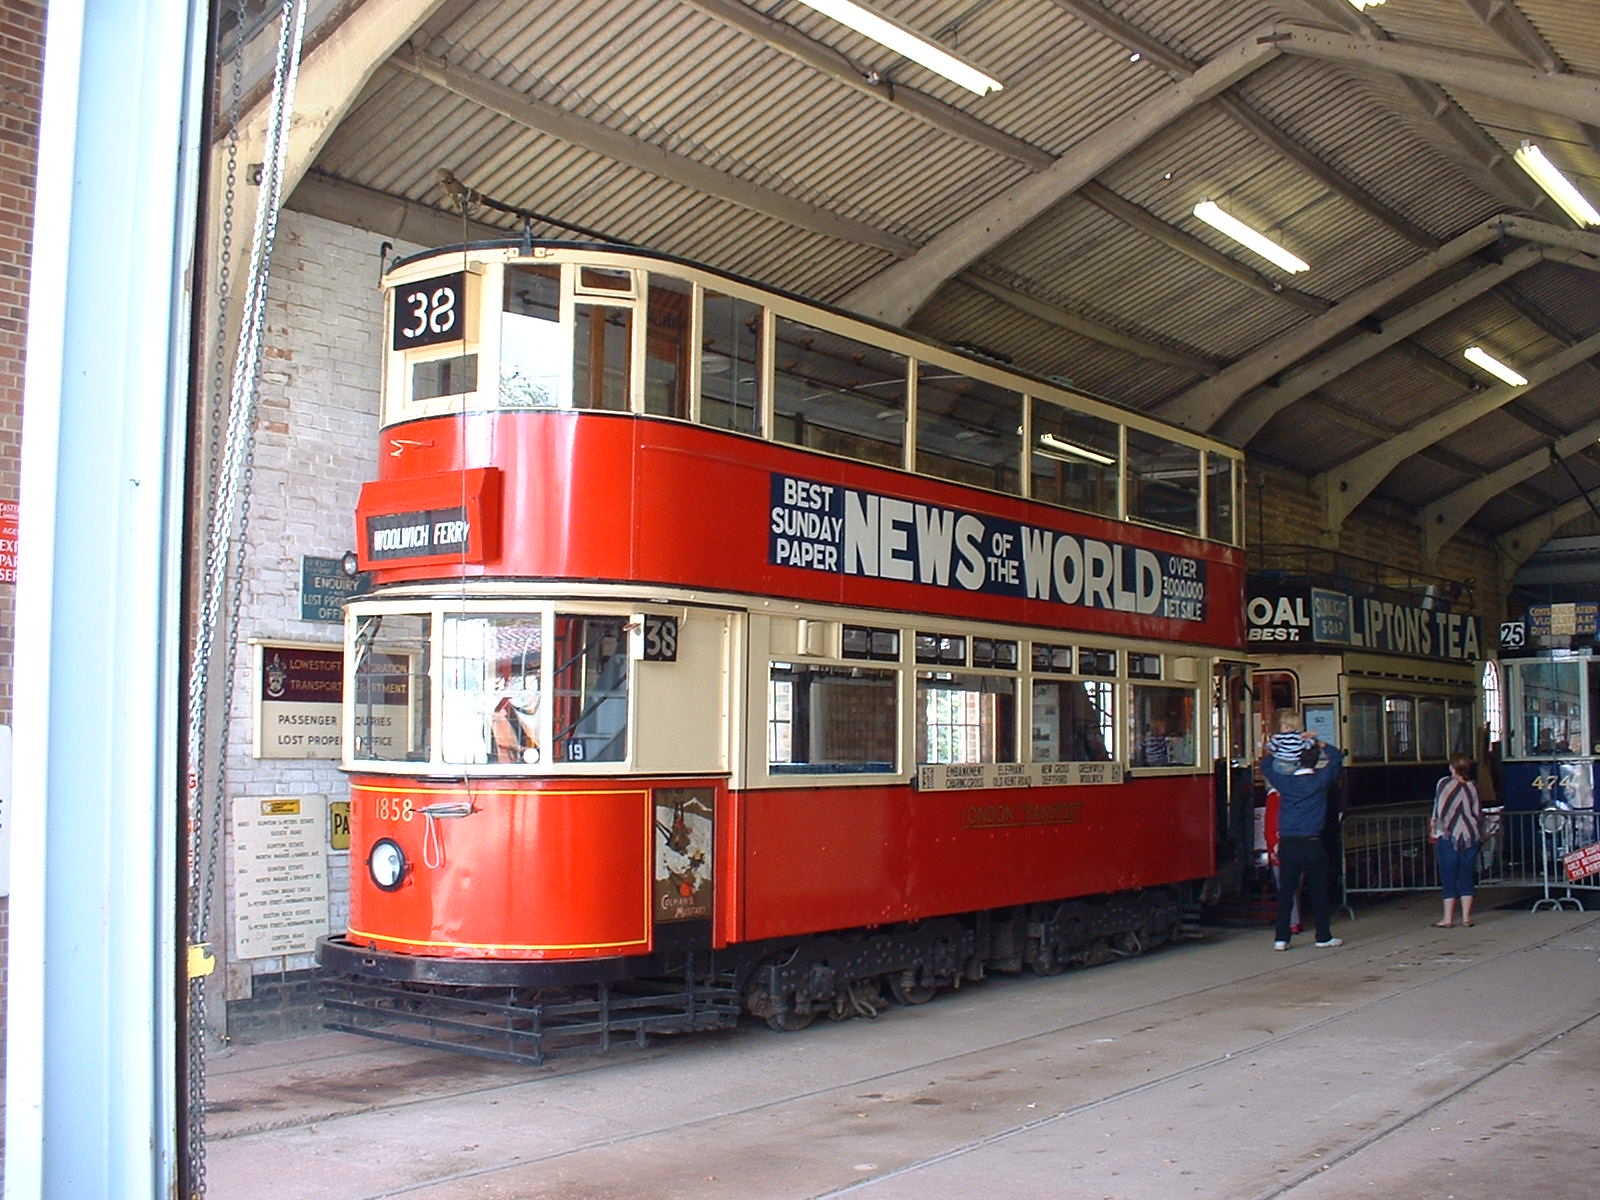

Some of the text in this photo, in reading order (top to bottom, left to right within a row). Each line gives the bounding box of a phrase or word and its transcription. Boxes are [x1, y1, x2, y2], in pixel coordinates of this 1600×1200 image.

[403, 287, 455, 338] 38
[784, 478, 833, 511] BEST
[374, 521, 470, 551] WOOLWICH FERRY
[771, 507, 843, 543] SUNDAY
[844, 490, 986, 591] NEWS
[992, 532, 1013, 556] OF
[776, 538, 837, 571] PAPER
[987, 557, 1019, 585] THE
[1020, 526, 1162, 616] WORLD
[1169, 557, 1197, 579] OVER
[314, 577, 360, 591] ENQUIRY
[303, 594, 322, 606] LOST
[1247, 597, 1310, 626] OAL
[646, 620, 677, 657] 38
[1349, 595, 1480, 660] LIPTONS TEA
[1502, 625, 1523, 645] 25
[290, 660, 342, 672] LOWESTOFT
[291, 680, 342, 692] TRANSPORT
[278, 715, 337, 725] PASSENGER
[278, 736, 303, 745] LOST
[308, 736, 342, 746] PROPE
[568, 744, 584, 760] 19
[1532, 775, 1573, 790] 474
[375, 799, 413, 822] 1858
[334, 813, 350, 835] PA
